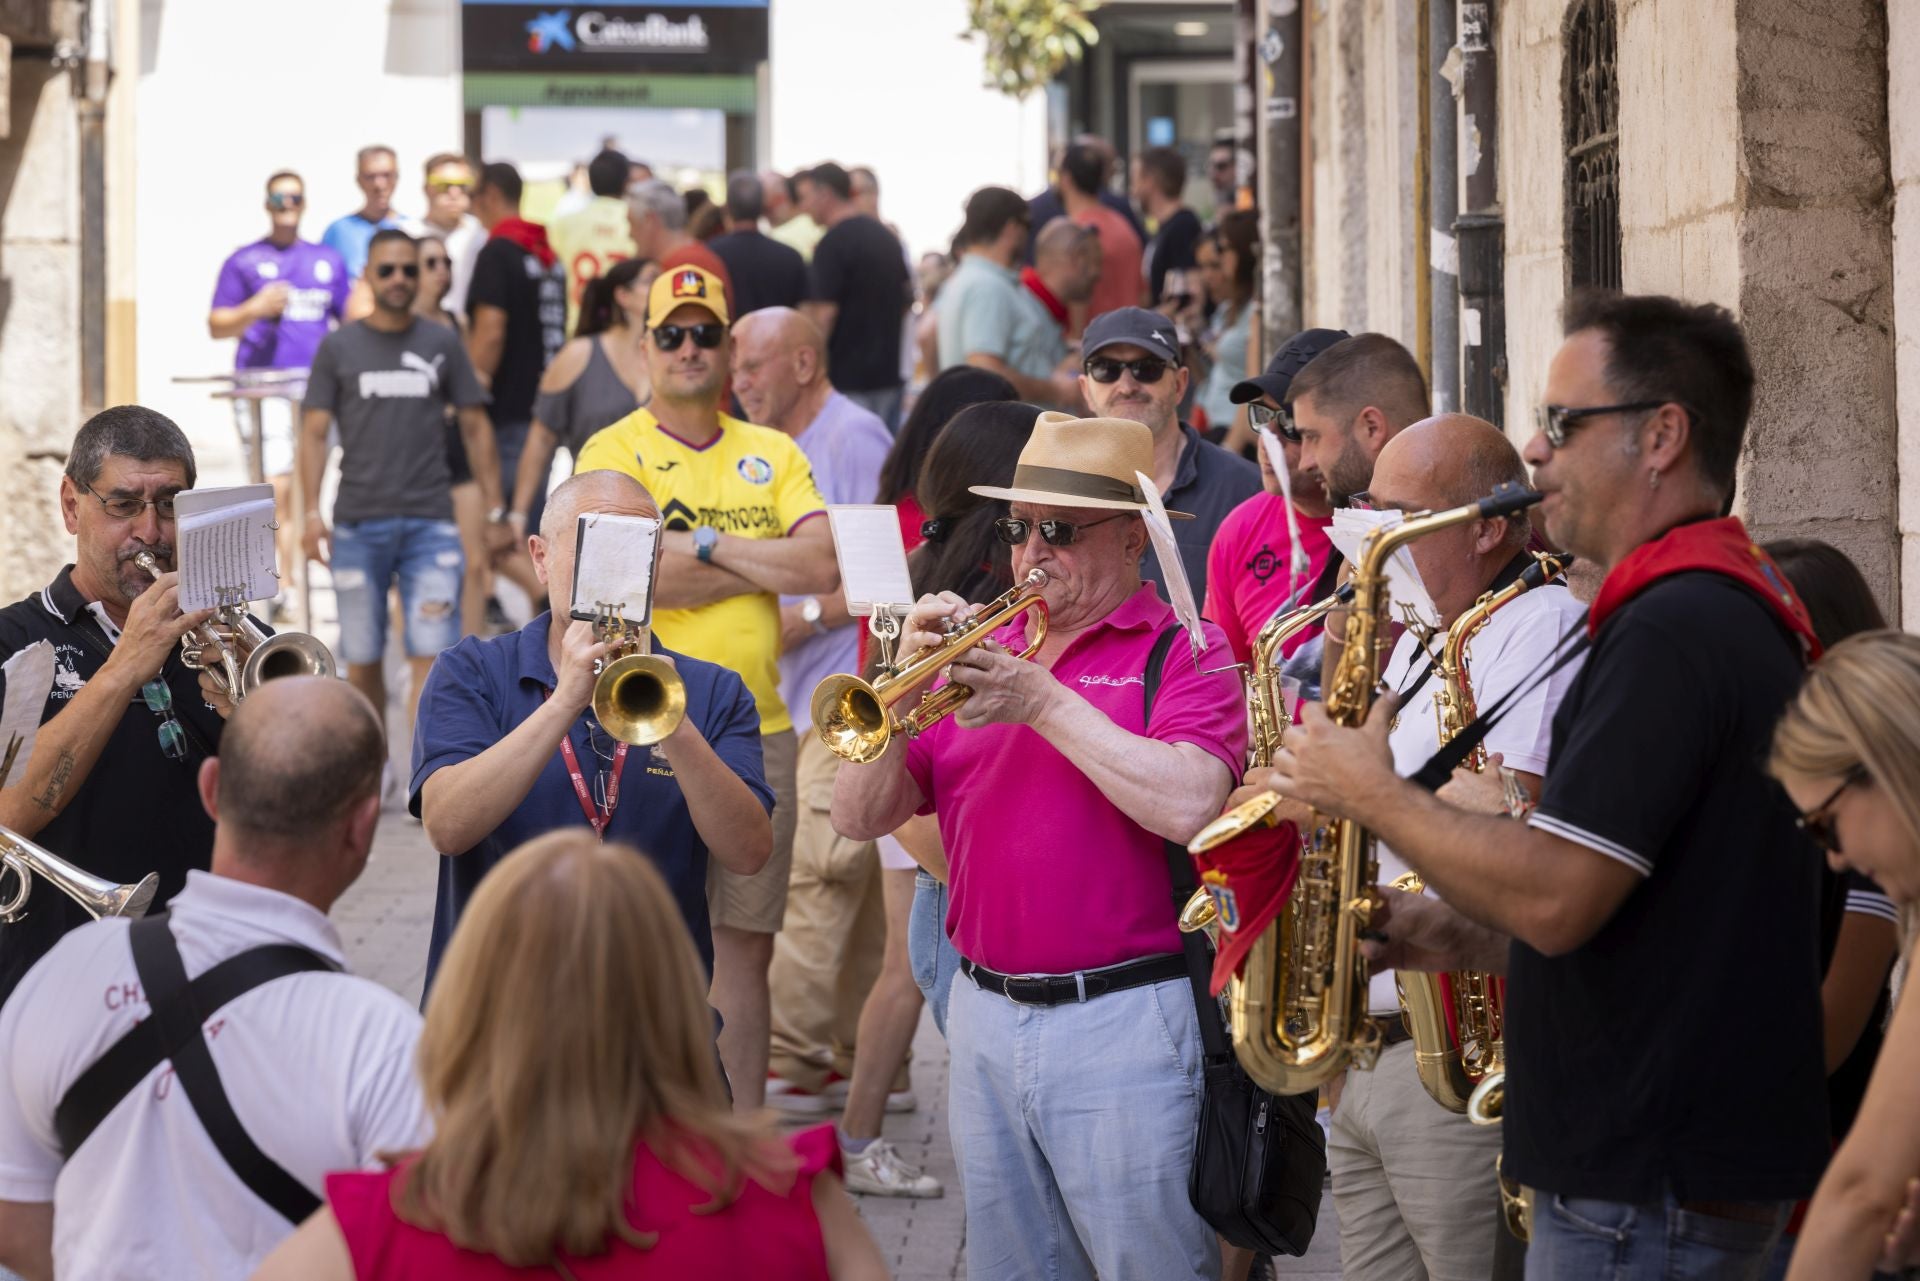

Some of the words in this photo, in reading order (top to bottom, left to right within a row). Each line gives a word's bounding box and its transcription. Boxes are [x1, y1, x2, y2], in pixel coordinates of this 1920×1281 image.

[359, 370, 430, 399] PUMA
[51, 688, 75, 699] PEÑA
[646, 767, 675, 777] PEÑAF
